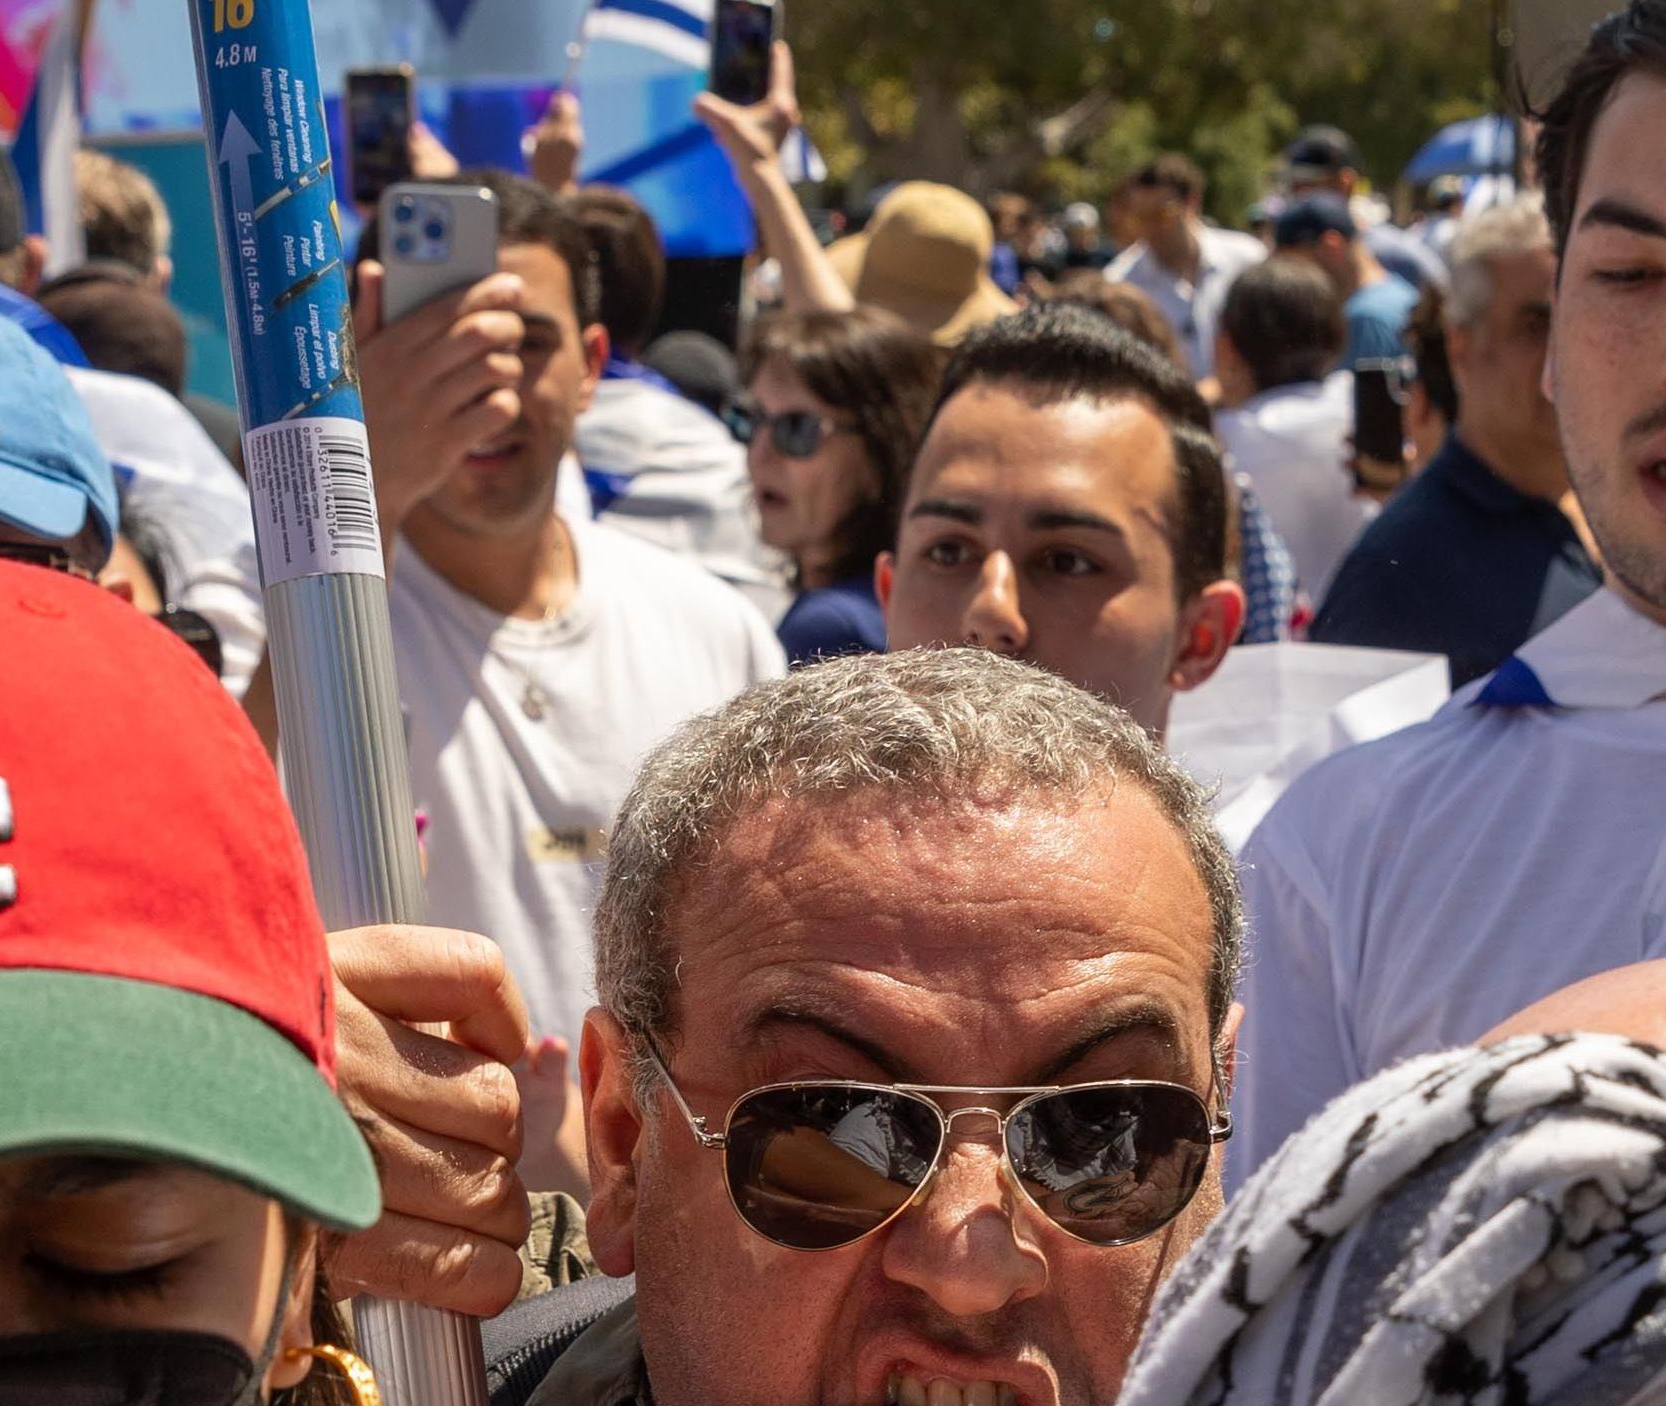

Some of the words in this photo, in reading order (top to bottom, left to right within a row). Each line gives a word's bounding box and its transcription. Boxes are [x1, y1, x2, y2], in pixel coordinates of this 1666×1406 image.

[215, 43, 240, 70] 4.8
[294, 79, 307, 119] Window
[267, 118, 279, 137] des
[277, 67, 289, 91] Para
[285, 128, 299, 173] ventanas
[300, 120, 312, 164] Cleaning
[314, 220, 326, 261] Painting
